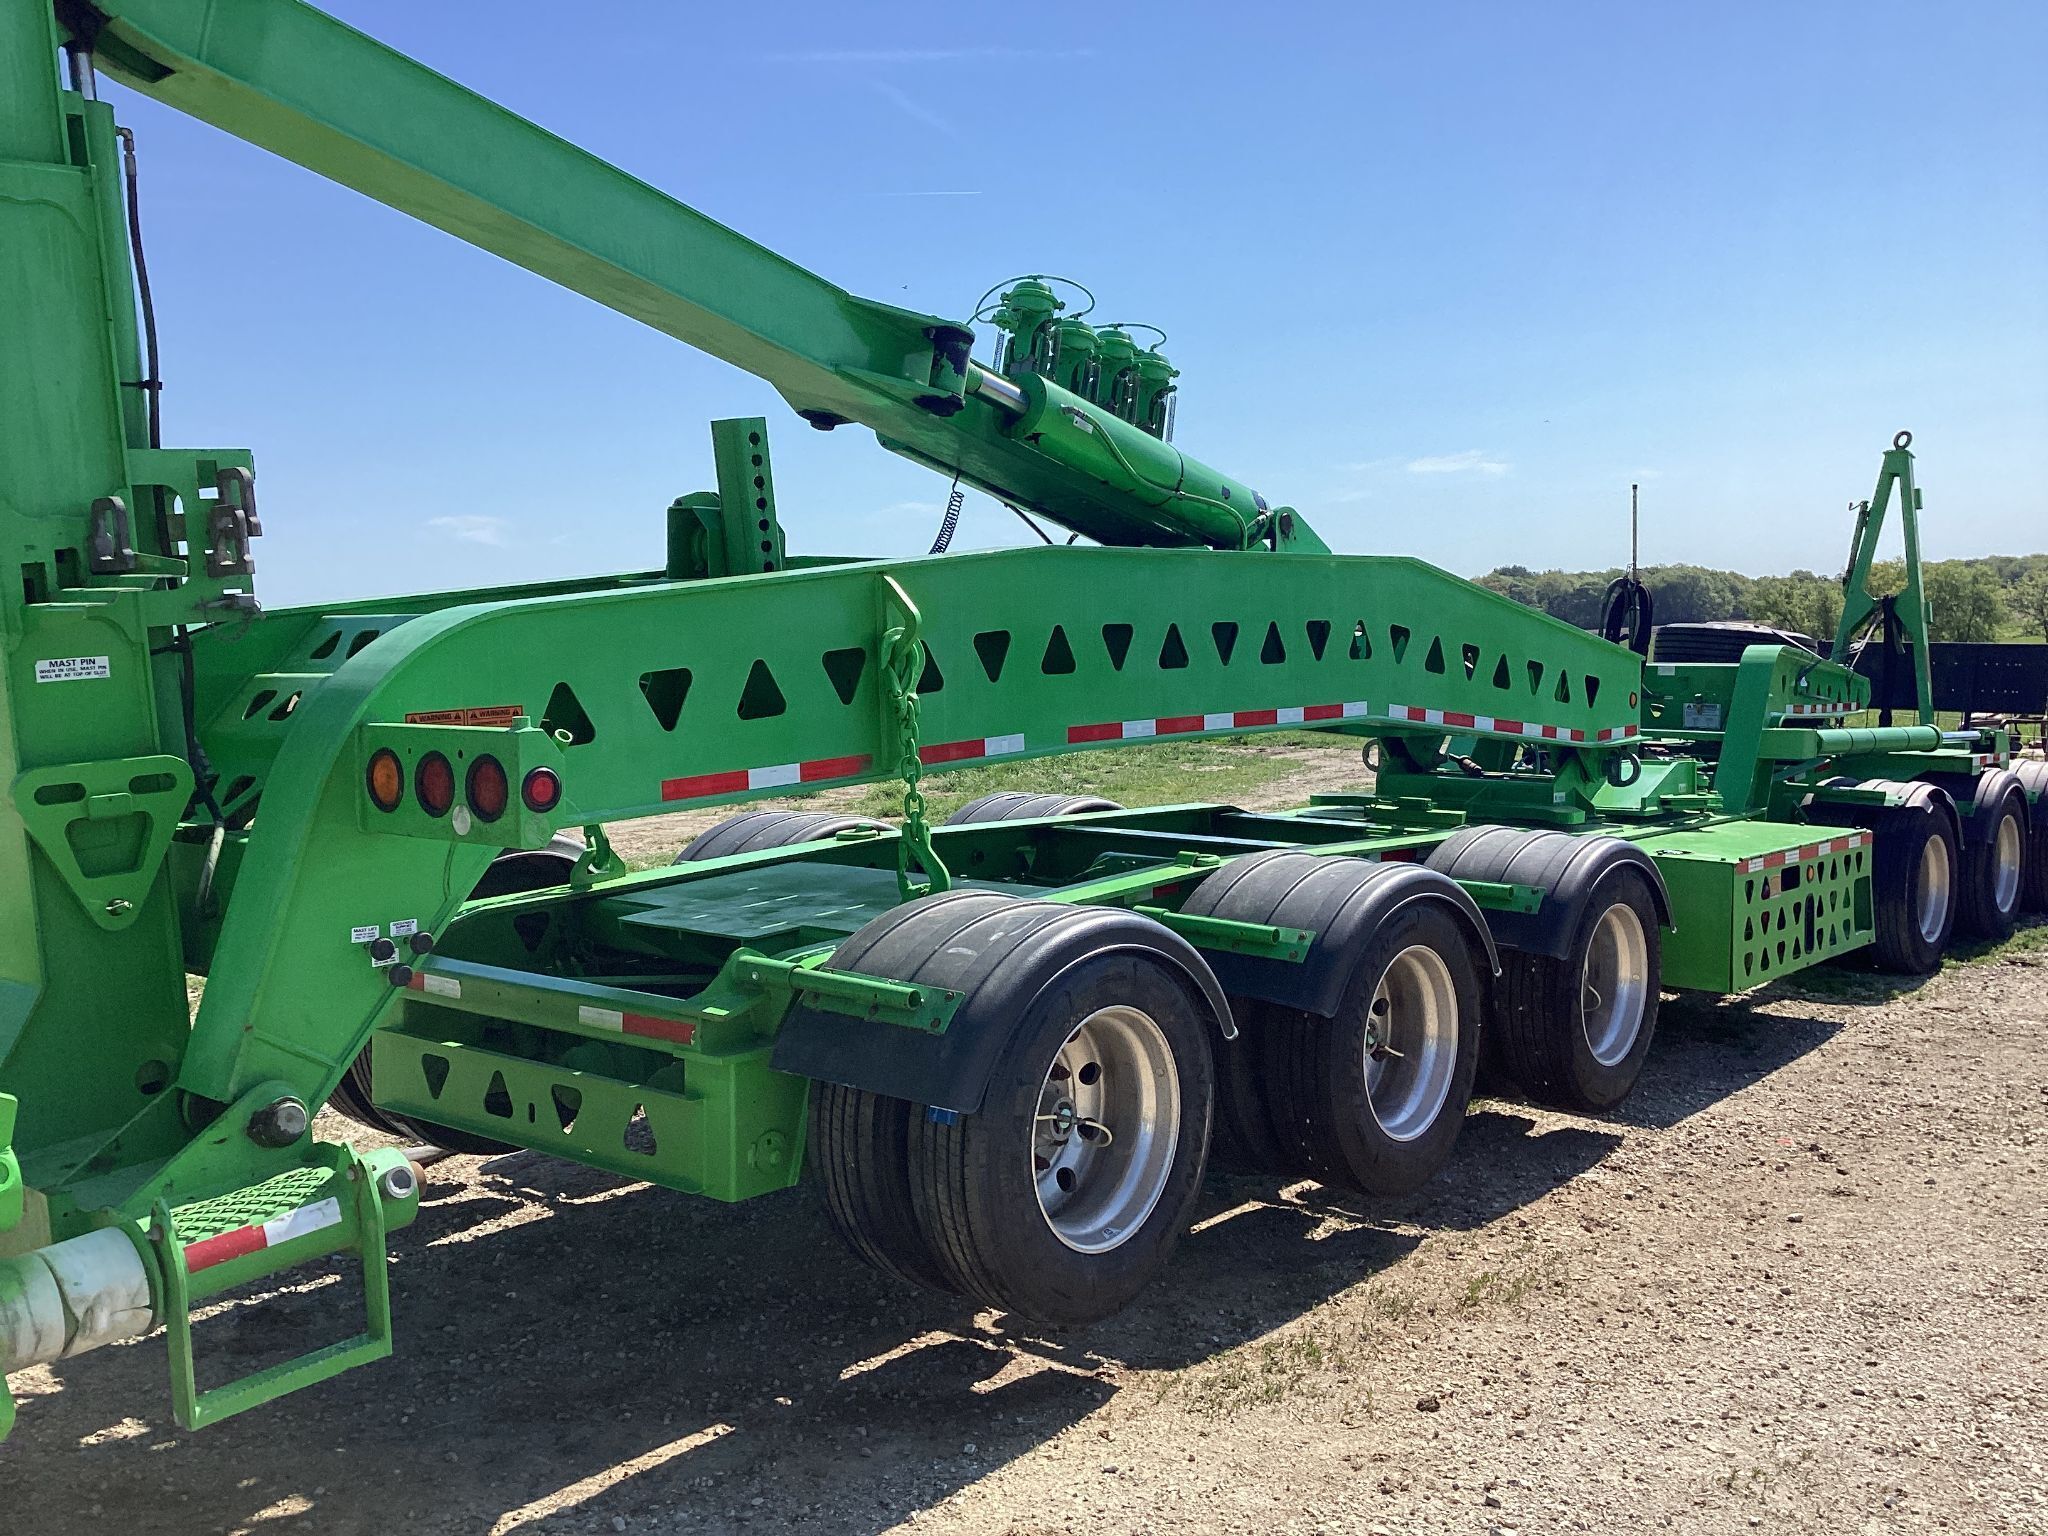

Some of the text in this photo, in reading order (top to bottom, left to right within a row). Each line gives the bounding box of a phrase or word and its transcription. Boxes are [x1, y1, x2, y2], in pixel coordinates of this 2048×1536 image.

[49, 660, 76, 668] MAST
[479, 709, 510, 718] WARNING
[419, 714, 451, 722] WARNING
